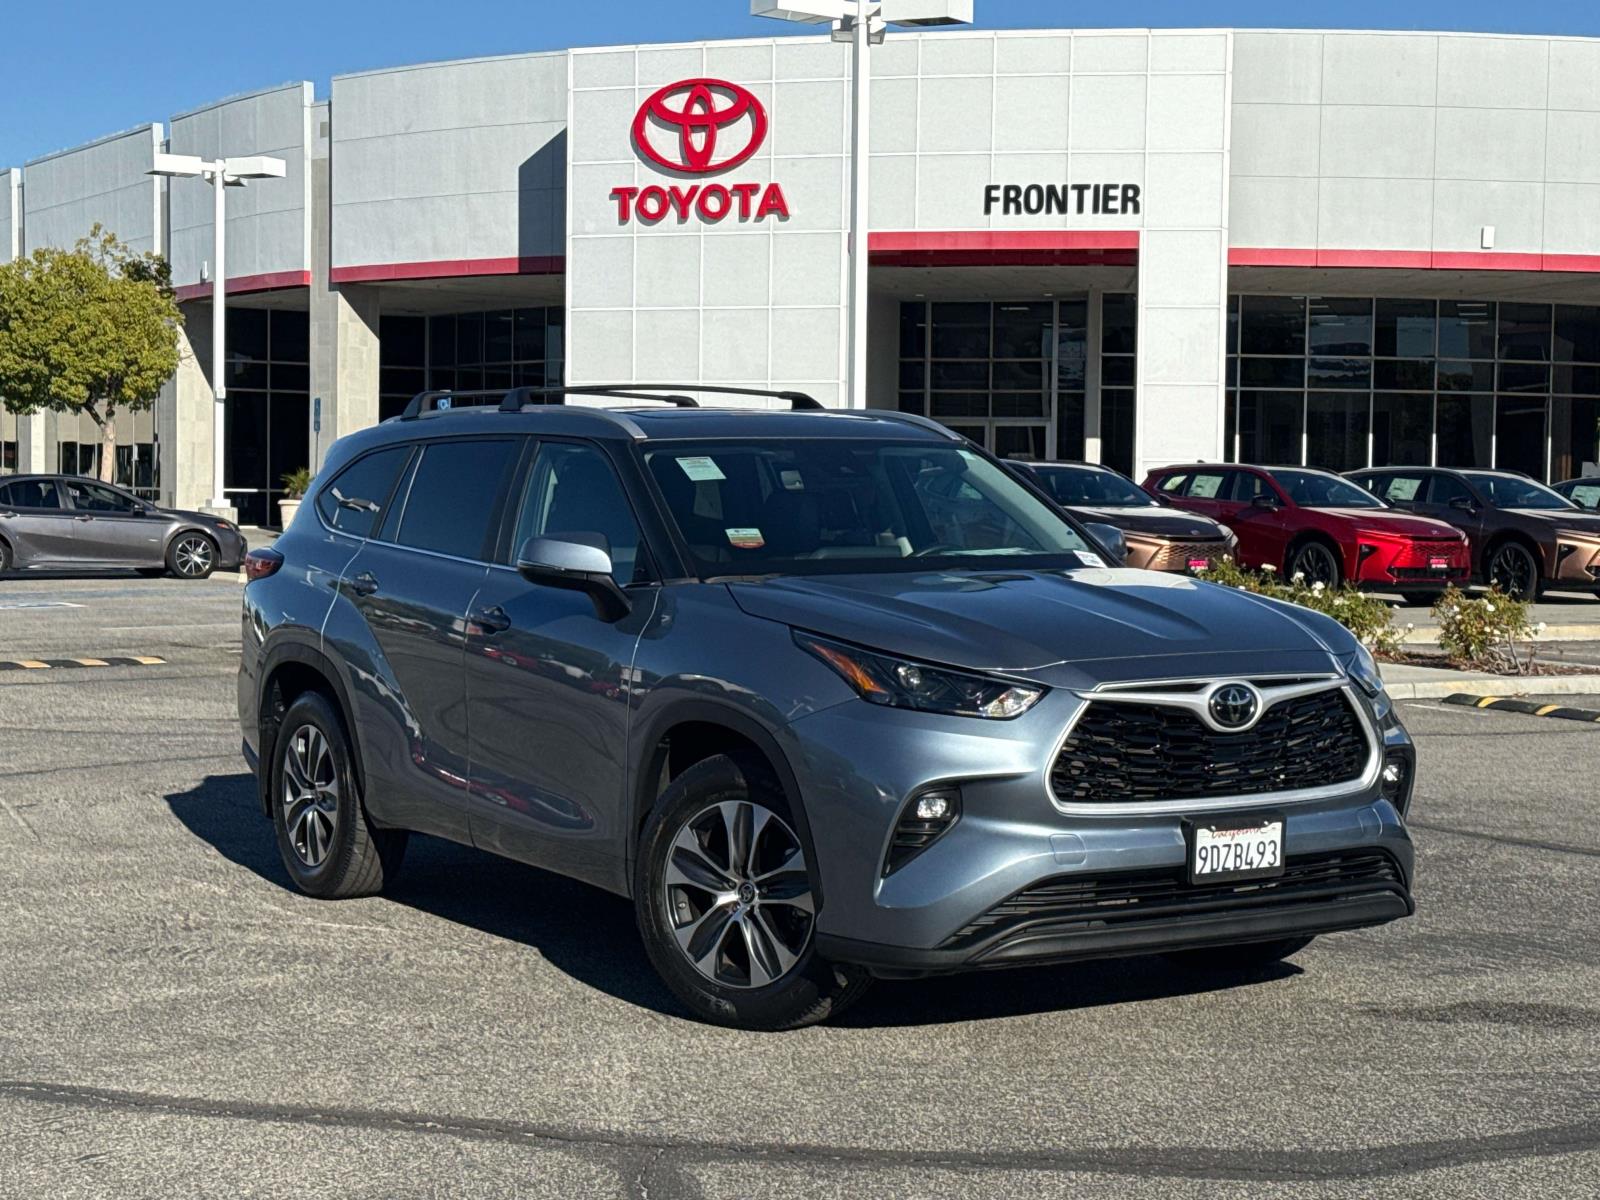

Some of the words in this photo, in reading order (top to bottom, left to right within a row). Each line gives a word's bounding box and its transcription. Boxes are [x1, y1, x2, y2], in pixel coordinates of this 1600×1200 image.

[611, 183, 790, 222] TOYOTA
[983, 184, 1141, 215] FRONTIER
[1198, 840, 1277, 873] 9DZB493
